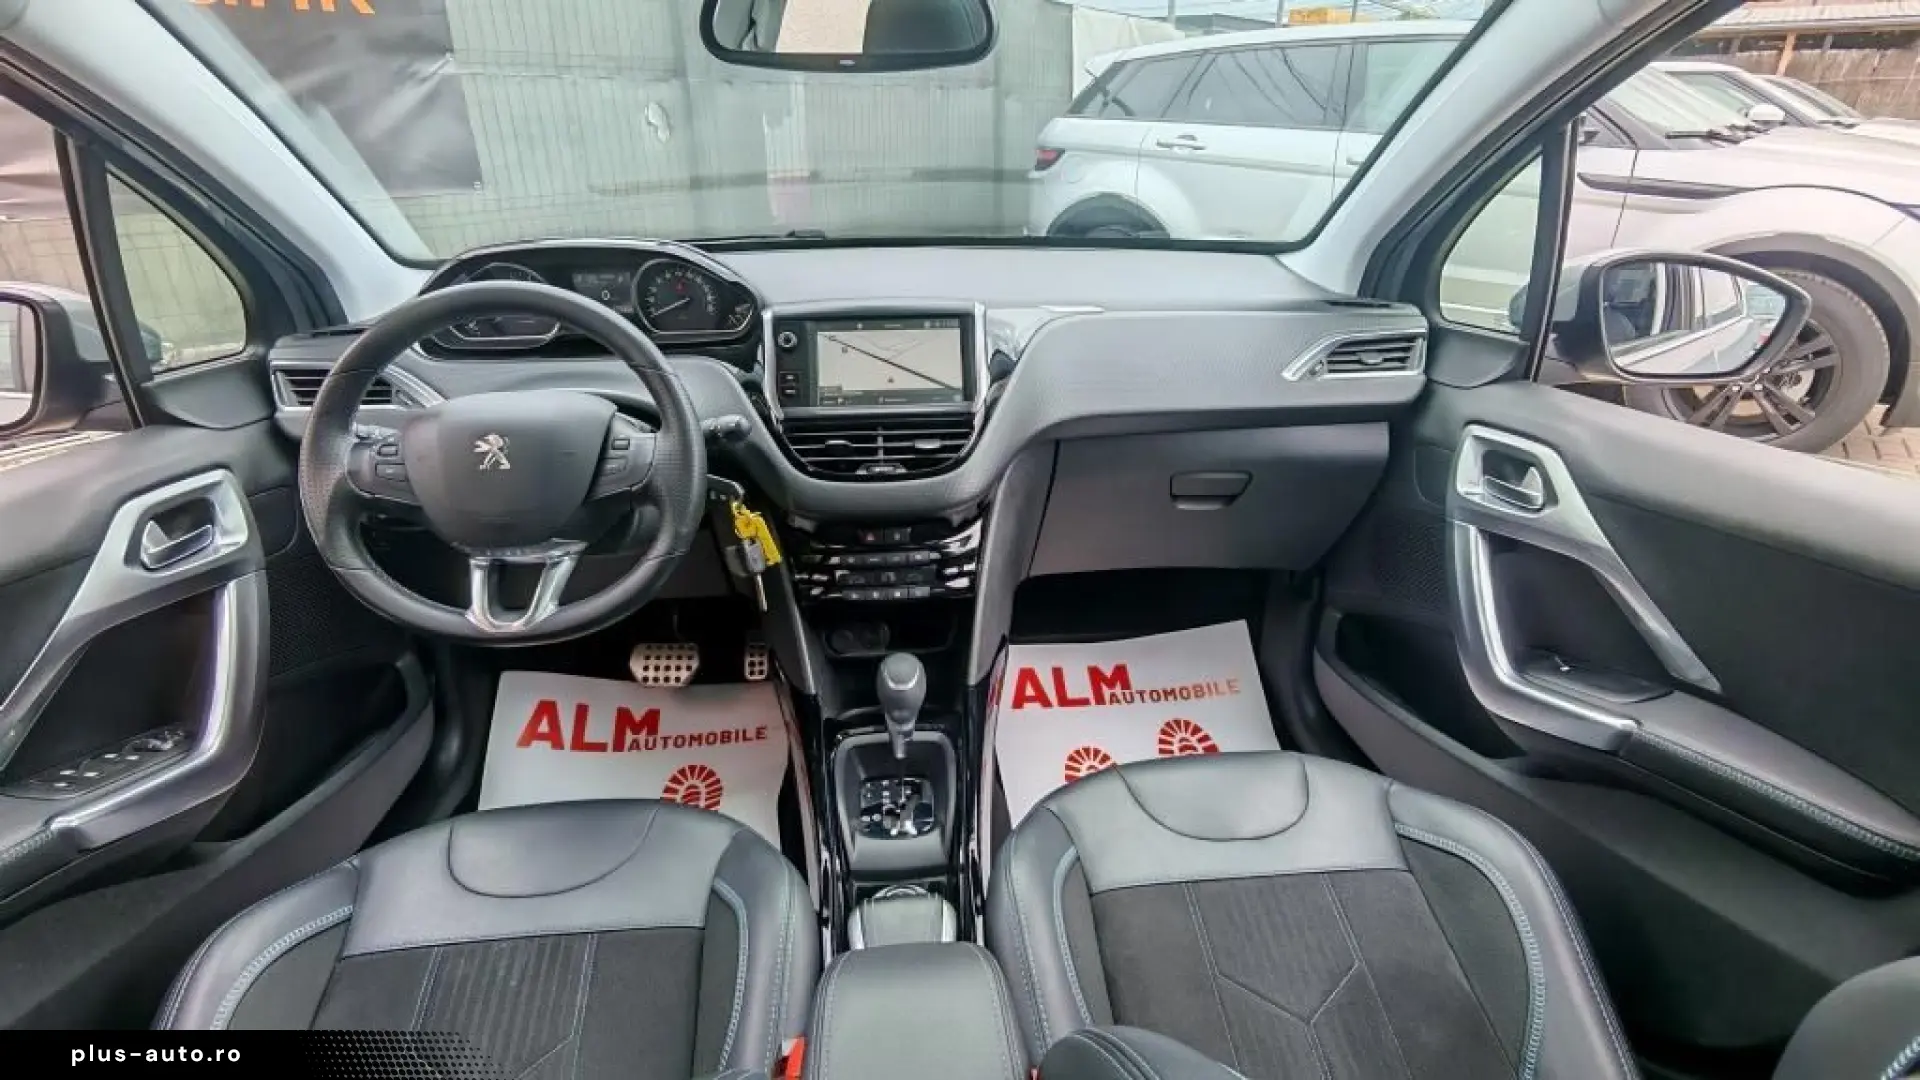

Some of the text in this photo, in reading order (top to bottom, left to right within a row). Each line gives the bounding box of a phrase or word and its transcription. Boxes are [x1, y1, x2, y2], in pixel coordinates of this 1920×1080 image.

[1011, 663, 1242, 709] ALM AUTOMOBILE
[516, 698, 769, 753] ALM AUTOMOBILE
